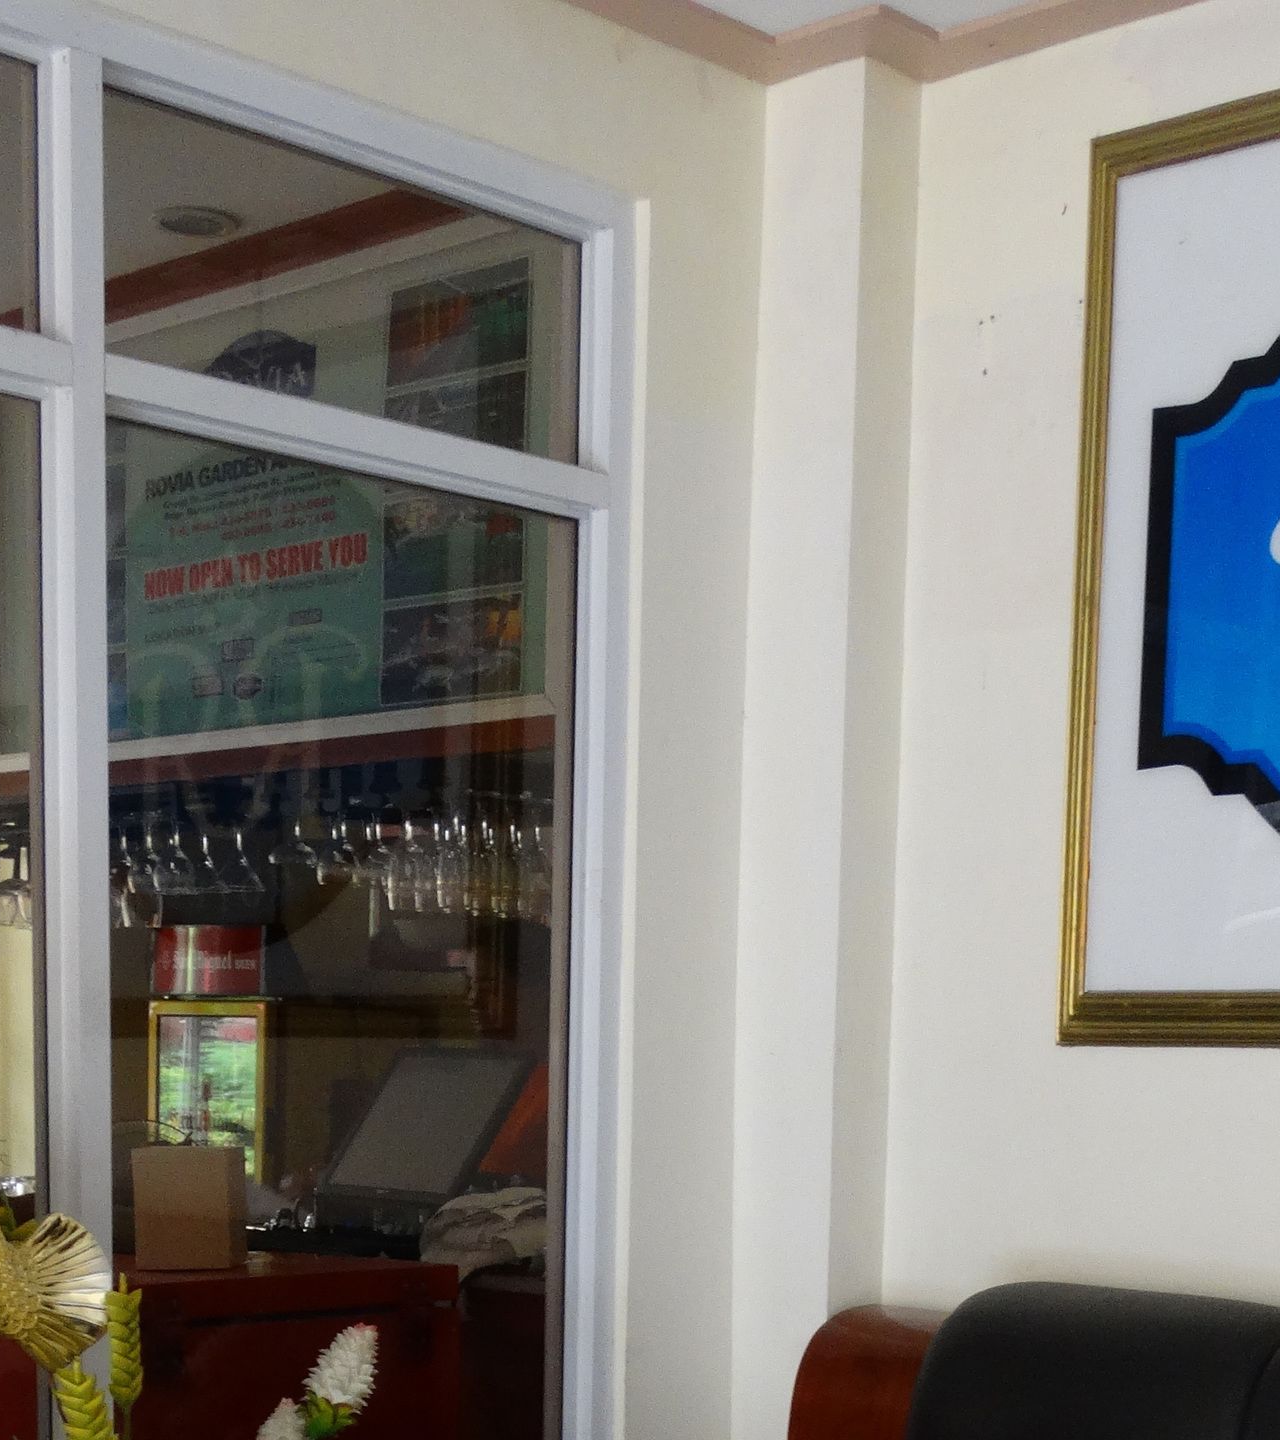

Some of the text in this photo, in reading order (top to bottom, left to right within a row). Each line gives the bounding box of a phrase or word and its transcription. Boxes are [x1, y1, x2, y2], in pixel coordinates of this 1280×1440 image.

[143, 532, 368, 601] NOW OPEN TO SERVE YOU
